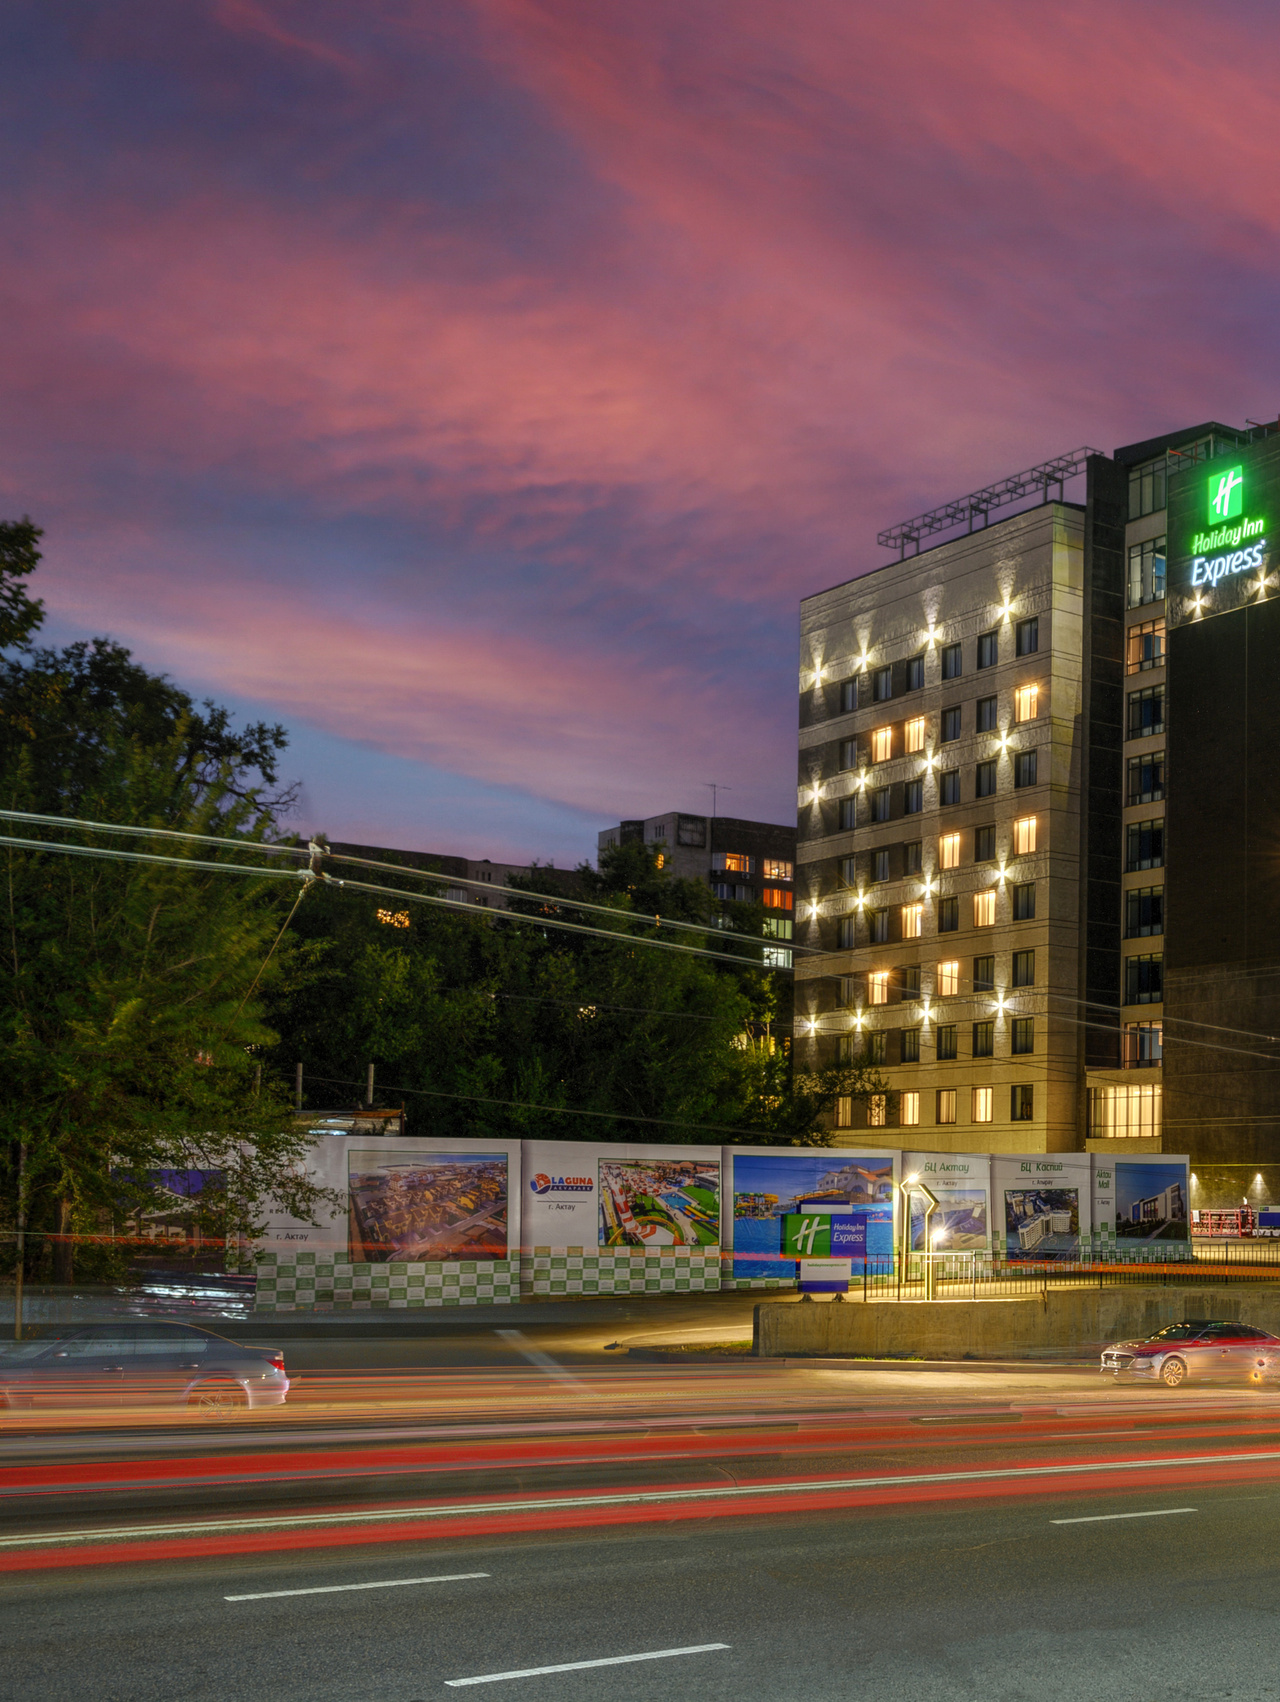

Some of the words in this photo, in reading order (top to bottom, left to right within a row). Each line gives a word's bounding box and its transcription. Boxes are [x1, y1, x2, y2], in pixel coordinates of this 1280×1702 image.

[1192, 526, 1241, 555] Holiday
[1242, 518, 1264, 538] Inn
[1191, 543, 1263, 587] Express
[924, 1162, 937, 1173] БЦ
[939, 1162, 970, 1174] Актау
[1020, 1162, 1032, 1173] БЦ
[1036, 1162, 1063, 1172] Каспий
[551, 1176, 594, 1185] LAGUNA
[1098, 1180, 1110, 1189] Mall
[833, 1223, 856, 1232] Holiday
[284, 1233, 309, 1241] Актау
[833, 1232, 864, 1244] Express
